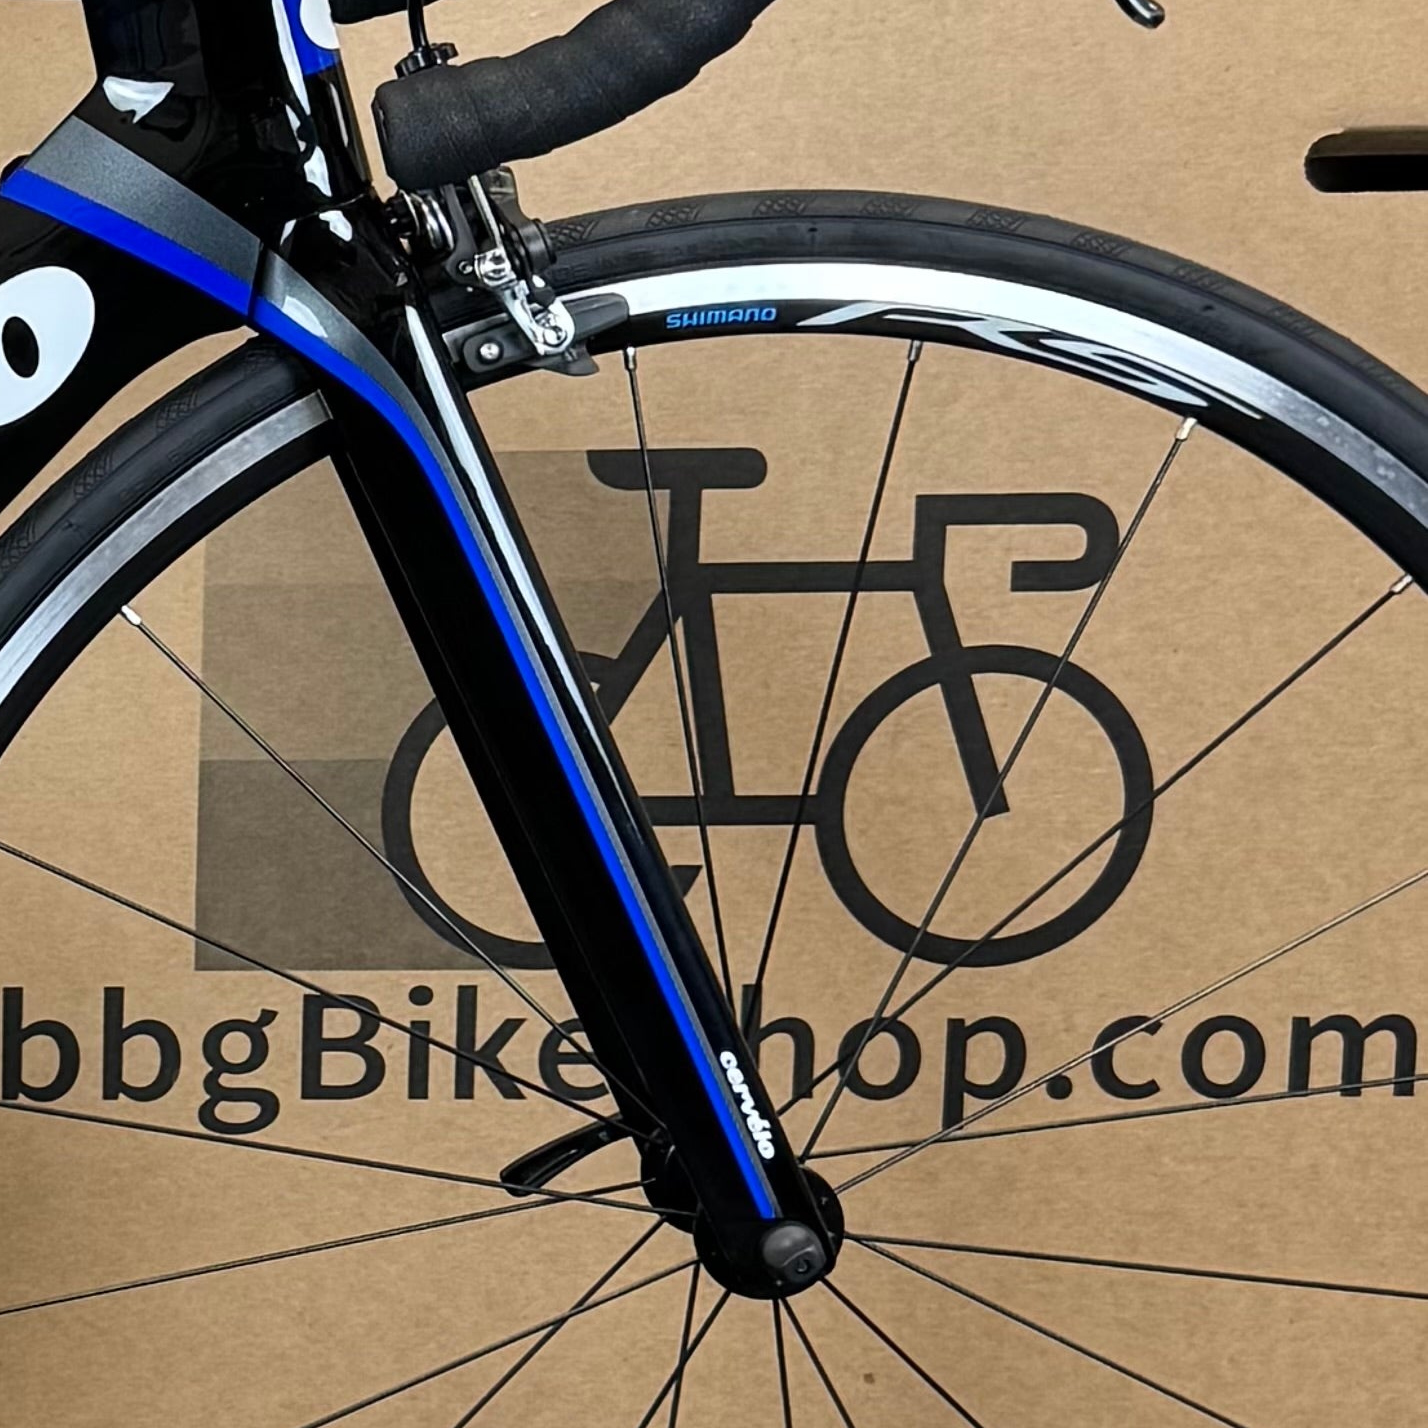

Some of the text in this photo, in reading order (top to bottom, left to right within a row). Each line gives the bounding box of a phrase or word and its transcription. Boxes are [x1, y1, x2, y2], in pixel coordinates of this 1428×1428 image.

[666, 307, 777, 329] SHIMANO
[0, 983, 1418, 1135] bbgBikehop.com
[719, 1051, 775, 1160] cervélo
